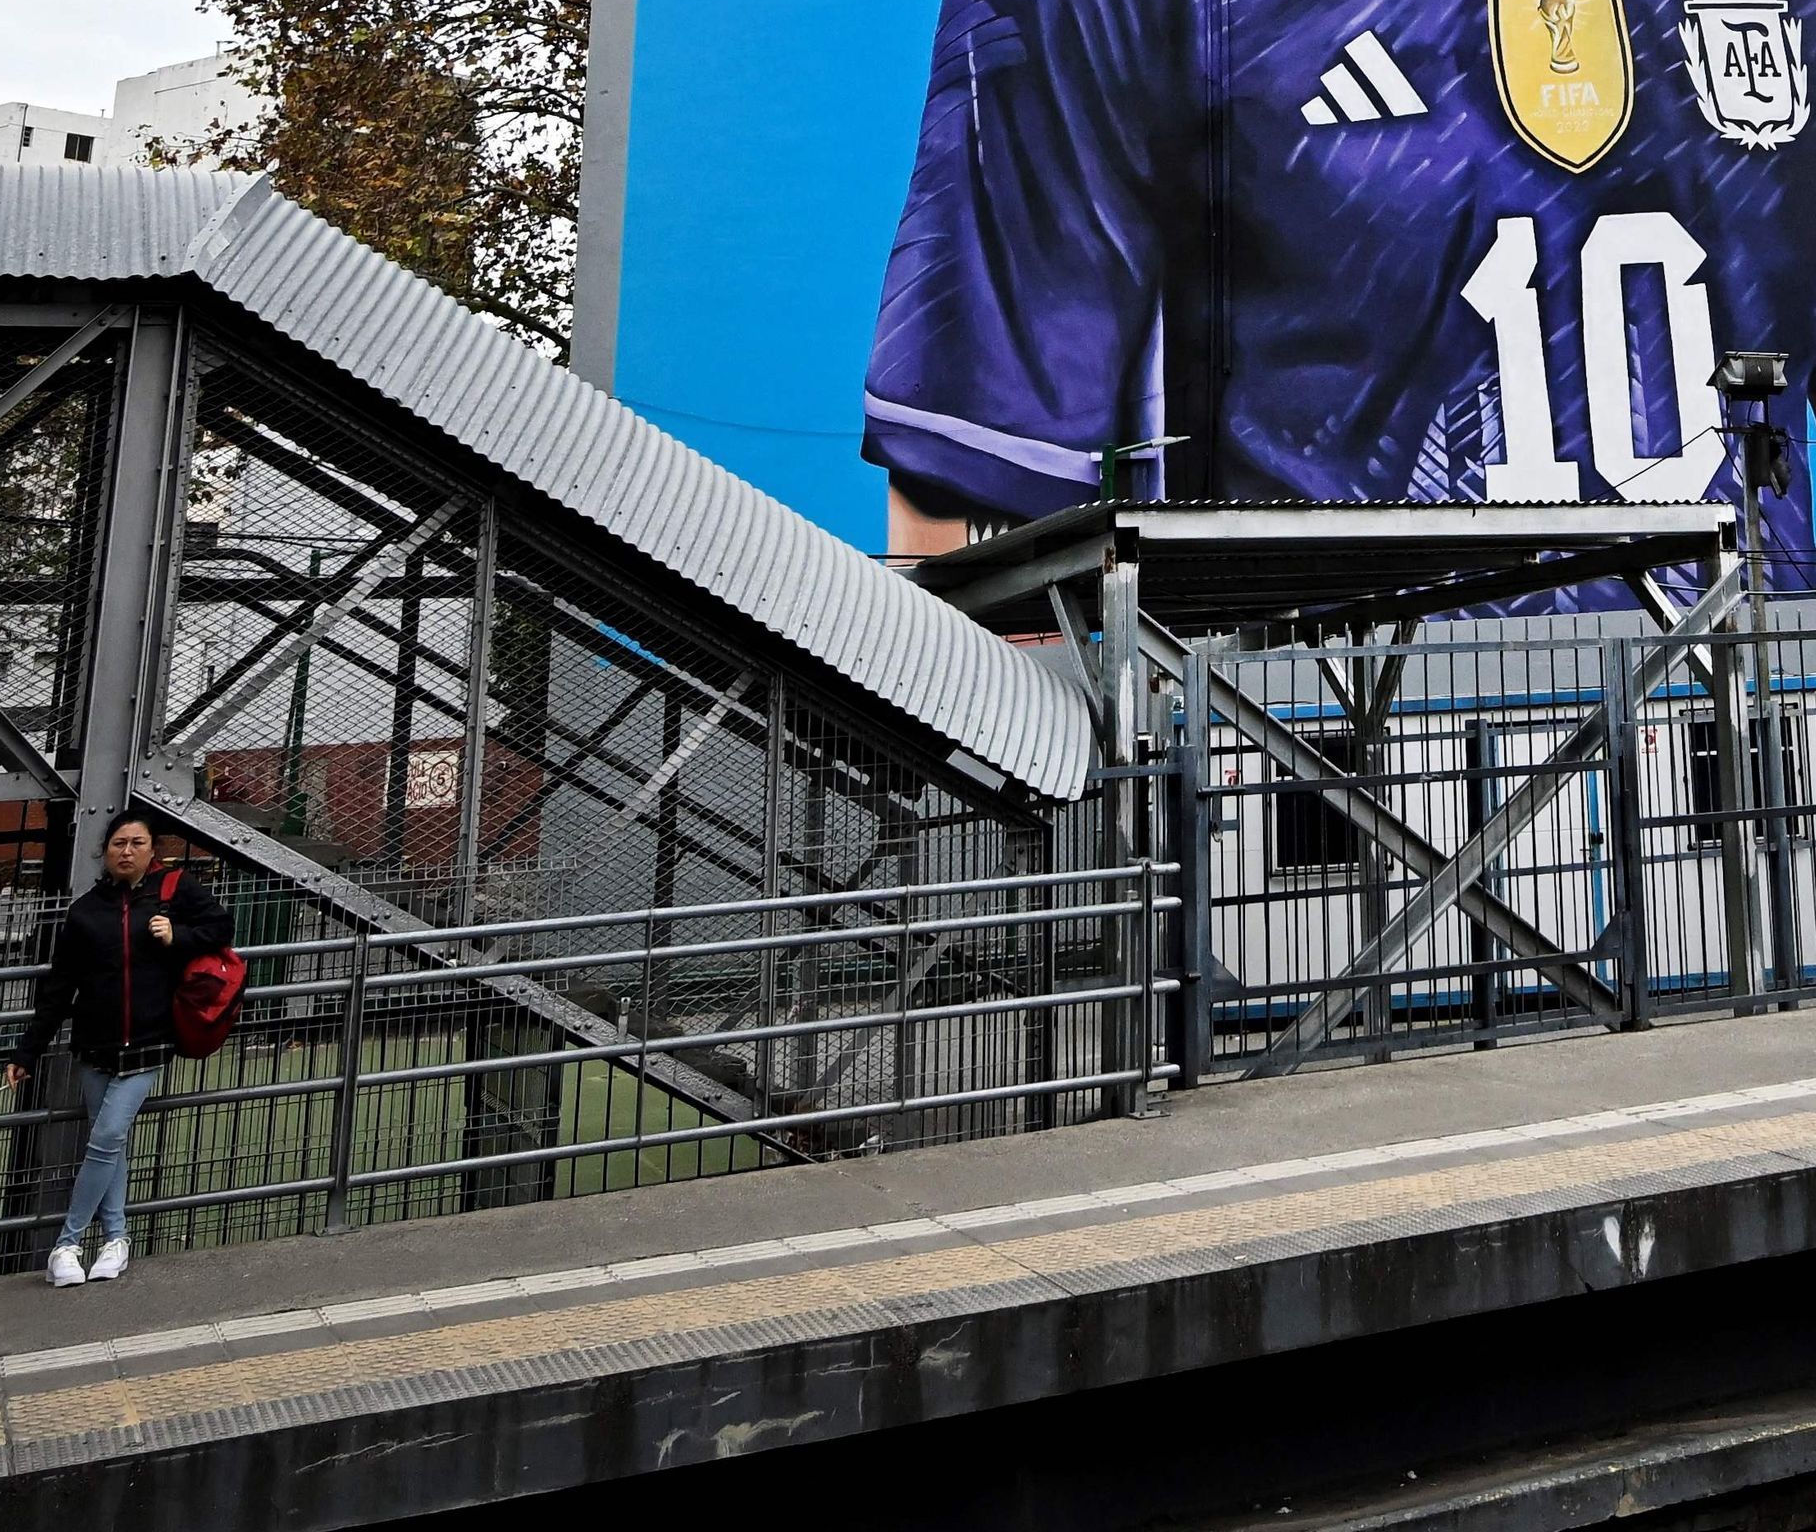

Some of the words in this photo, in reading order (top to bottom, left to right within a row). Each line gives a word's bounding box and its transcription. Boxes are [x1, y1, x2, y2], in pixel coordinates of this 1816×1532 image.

[1721, 19, 1782, 103] AFA
[1540, 81, 1599, 107] FIFA
[1460, 212, 1727, 502] 10
[437, 772, 445, 786] 5
